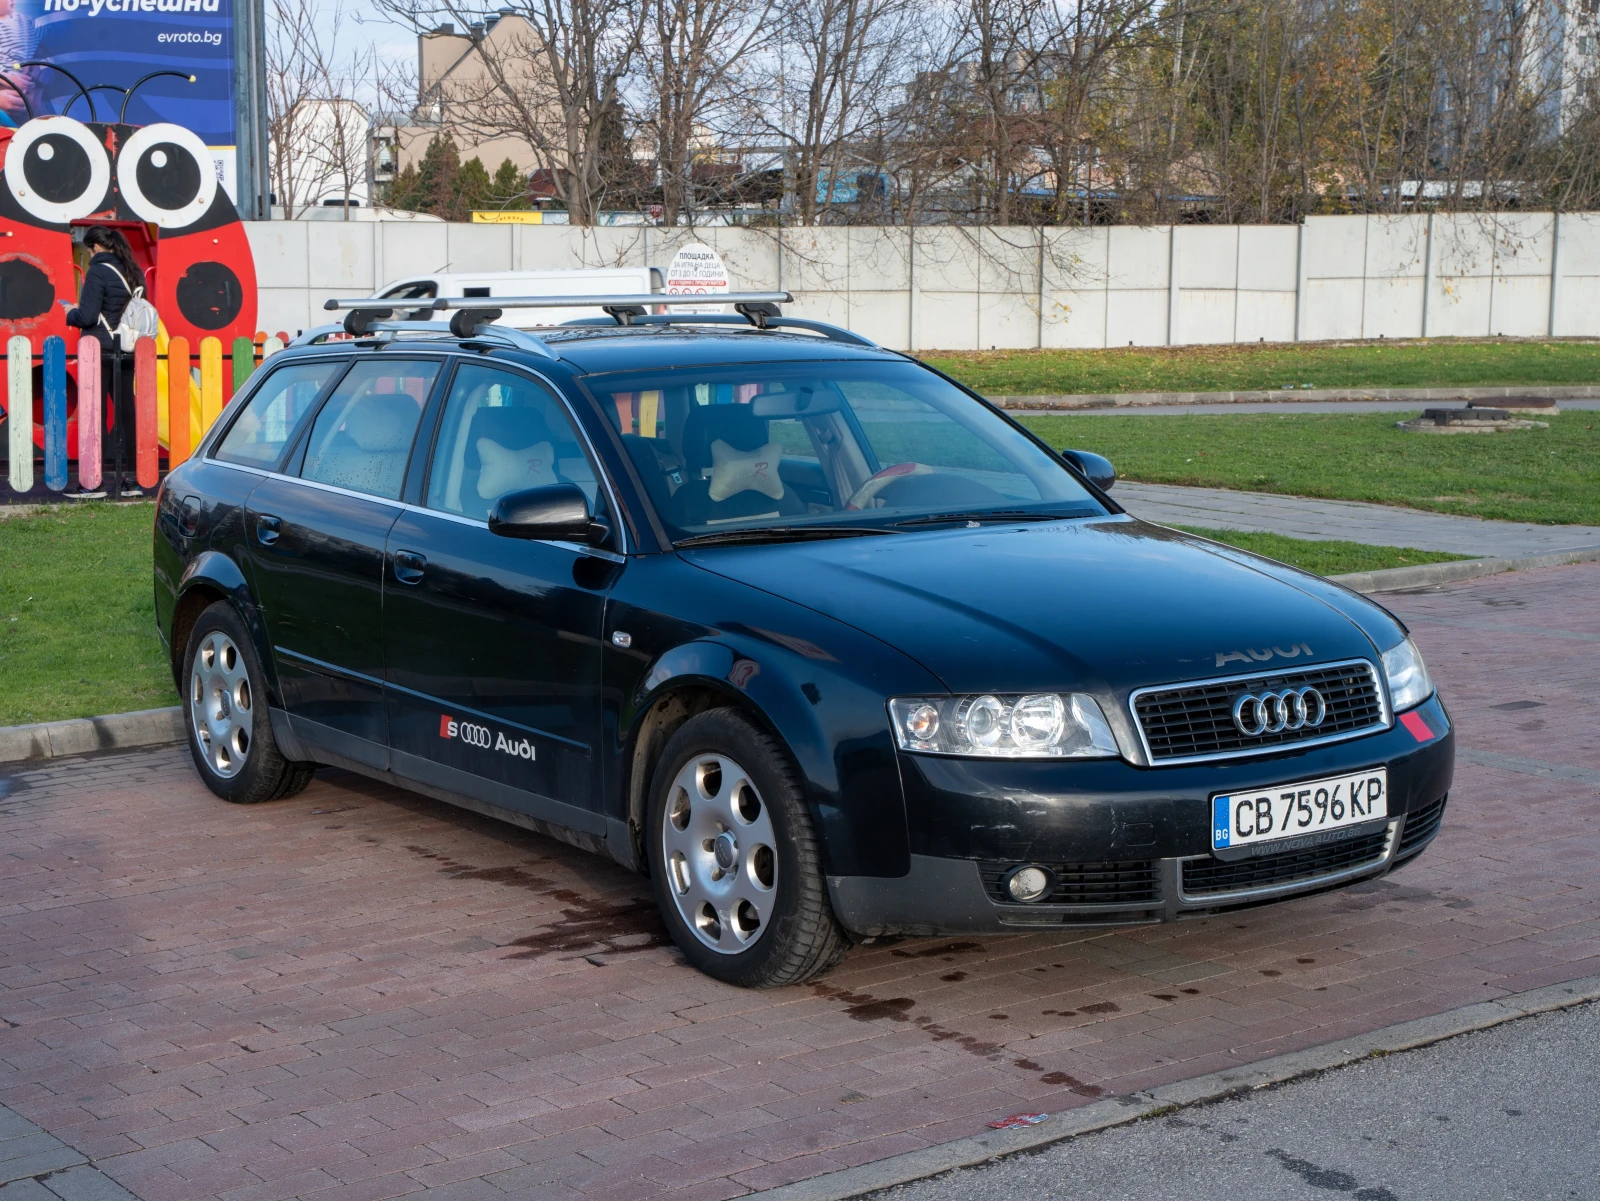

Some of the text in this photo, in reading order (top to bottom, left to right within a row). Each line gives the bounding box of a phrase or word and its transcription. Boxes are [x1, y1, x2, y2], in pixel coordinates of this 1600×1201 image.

[157, 31, 221, 45] evroto.bg
[680, 253, 714, 261] ПЛОЩАДКА
[682, 270, 691, 278] ДО
[699, 270, 724, 278] ГОДИНИ
[494, 732, 536, 762] Audi
[1235, 777, 1382, 838] CB 7596 KP
[1215, 828, 1229, 841] BG
